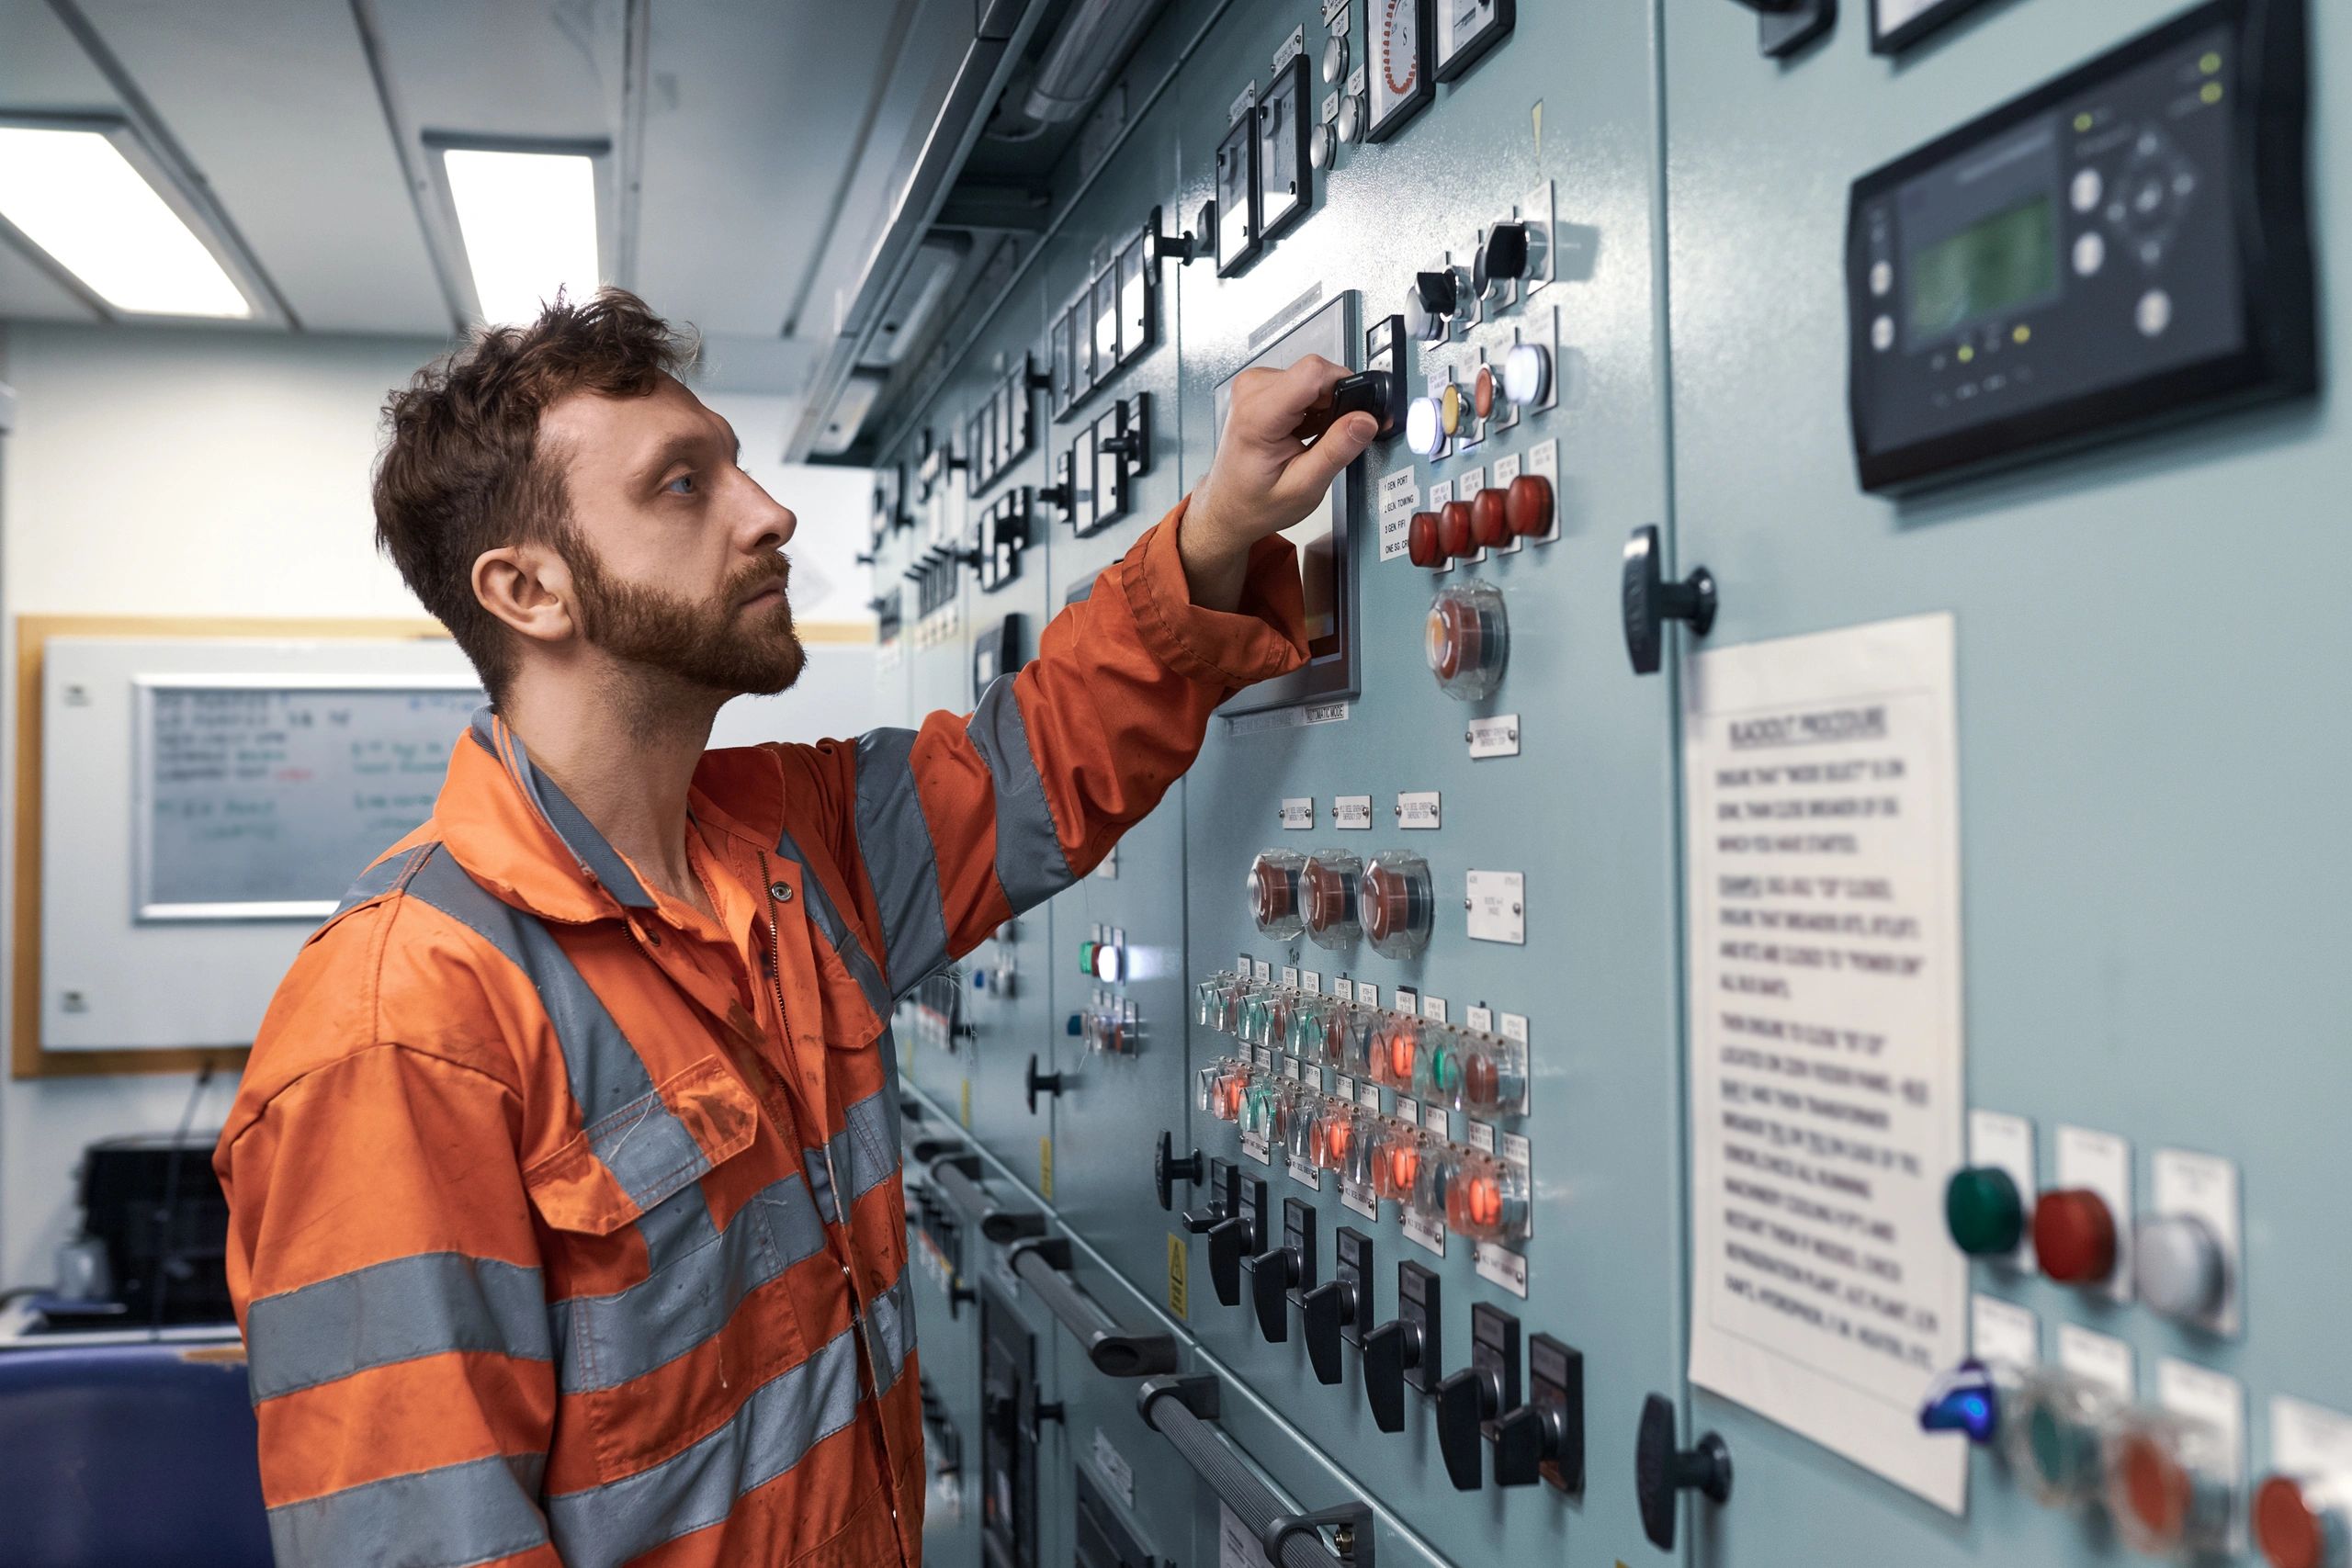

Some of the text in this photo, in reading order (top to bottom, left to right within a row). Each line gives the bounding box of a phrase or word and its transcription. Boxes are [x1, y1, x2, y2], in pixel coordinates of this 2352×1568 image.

[1396, 474, 1408, 487] PORT
[1397, 493, 1414, 507] TOWING
[1385, 544, 1394, 554] ONE
[1330, 705, 1343, 717] MODE
